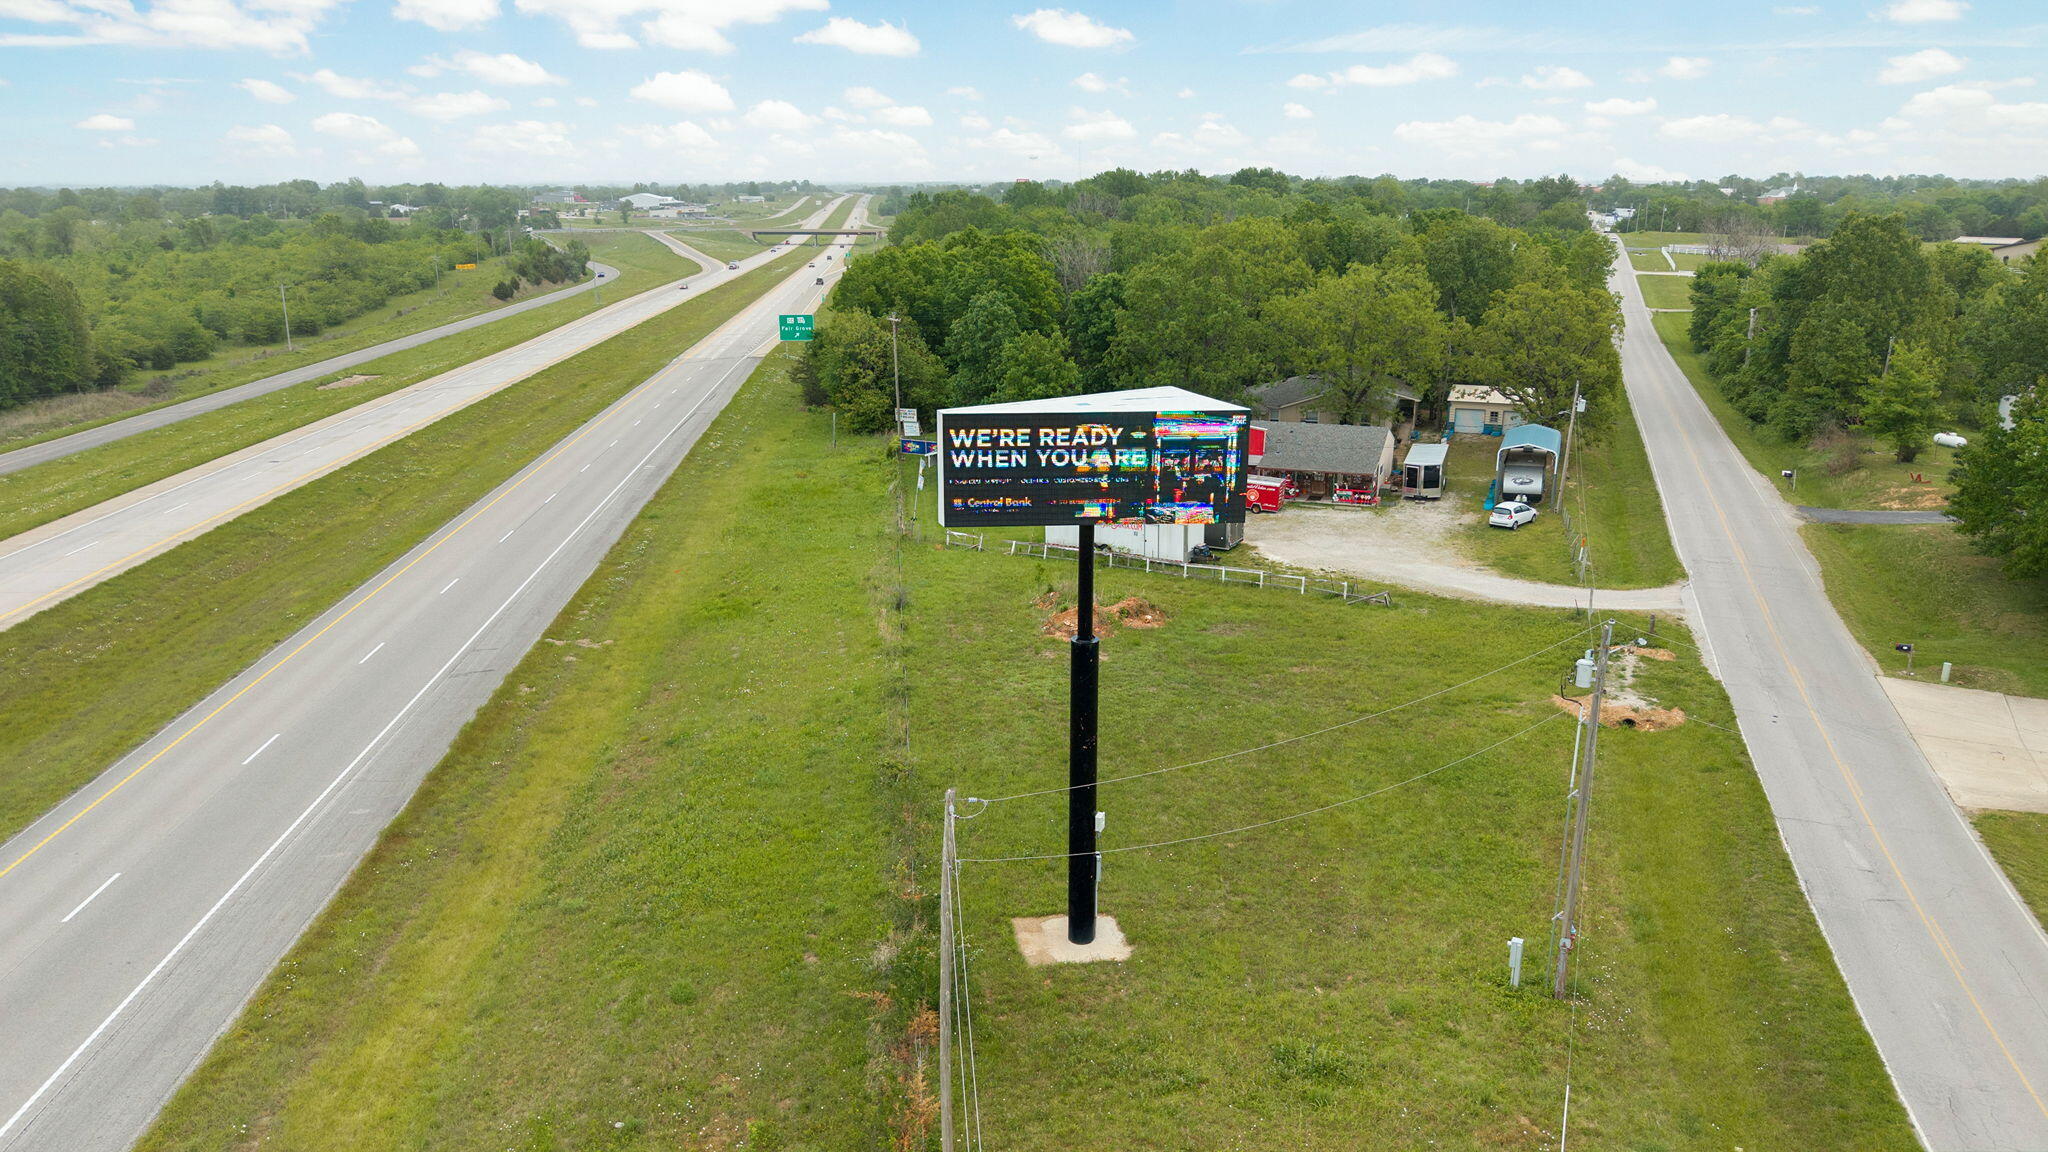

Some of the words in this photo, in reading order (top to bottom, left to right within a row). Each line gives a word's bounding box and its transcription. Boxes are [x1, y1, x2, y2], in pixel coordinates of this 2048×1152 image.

[1039, 427, 1124, 447] READY
[950, 449, 1027, 468] WHEN
[1036, 448, 1088, 467] YOU
[1096, 448, 1148, 467] ARE
[967, 497, 1004, 508] Central
[1005, 497, 1032, 507] Bank
